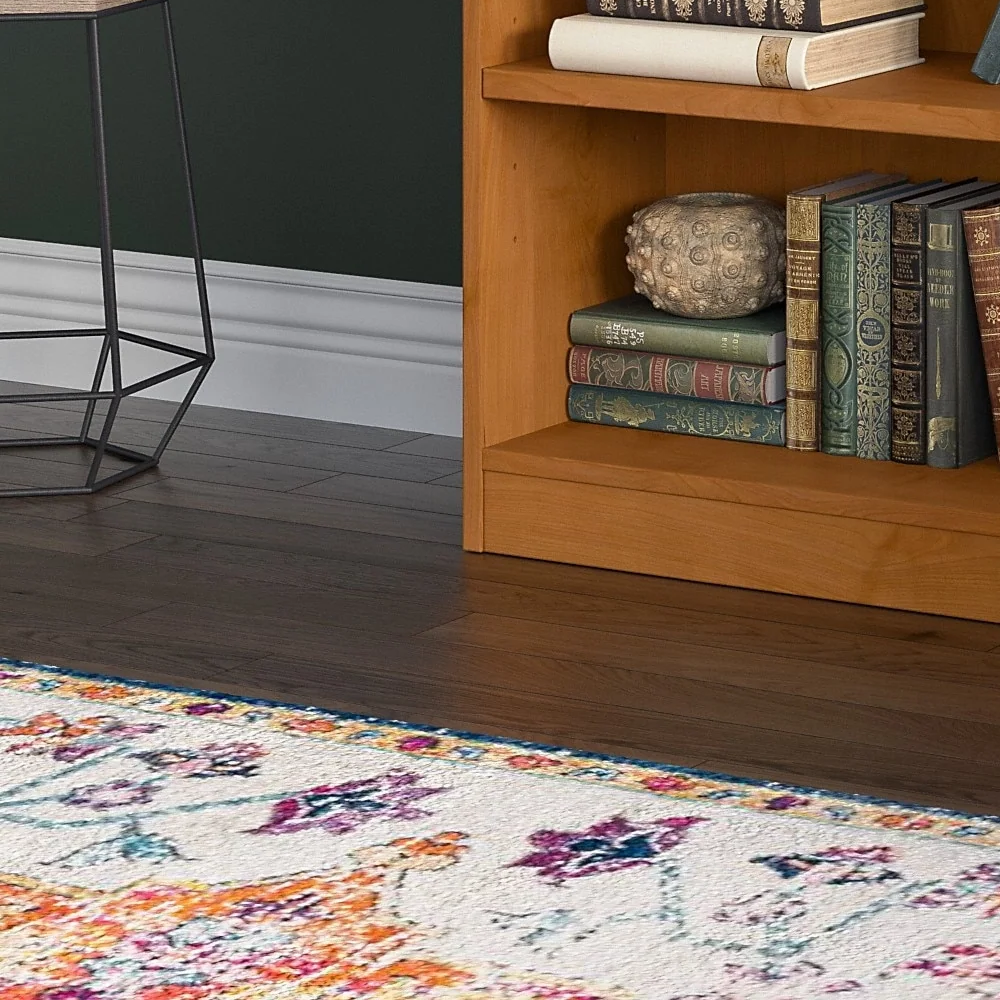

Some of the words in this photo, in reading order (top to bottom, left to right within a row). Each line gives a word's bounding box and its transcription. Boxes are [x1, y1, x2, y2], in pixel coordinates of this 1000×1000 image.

[929, 297, 951, 308] WORK
[629, 327, 637, 346] 549
[636, 331, 645, 345] PS
